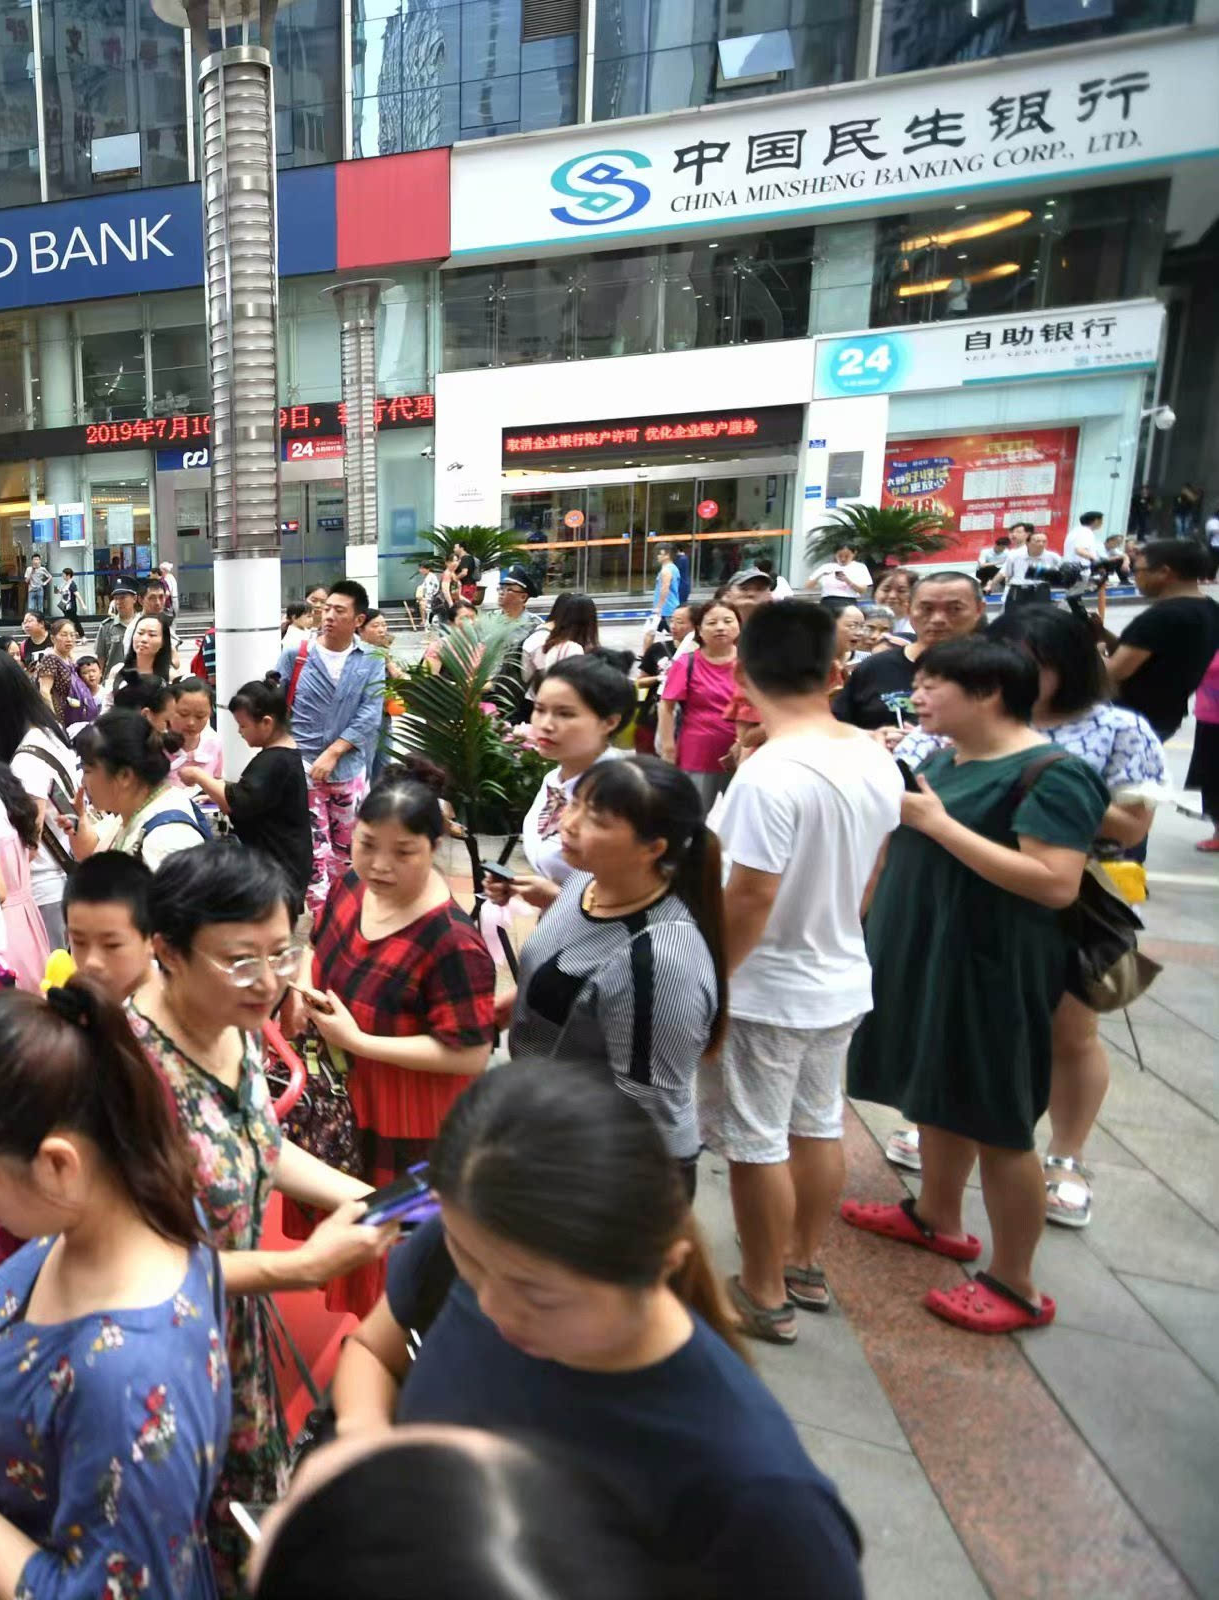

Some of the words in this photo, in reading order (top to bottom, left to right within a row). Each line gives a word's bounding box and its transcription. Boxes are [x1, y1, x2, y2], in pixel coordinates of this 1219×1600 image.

[673, 70, 1151, 187] 中国民生银行
[670, 190, 738, 213] CHINA
[745, 170, 866, 203] MINSHENG
[875, 154, 984, 186] BANKING
[1086, 130, 1143, 154] LTD.
[31, 214, 174, 274] BANK
[964, 317, 1117, 351] 自助银行
[837, 344, 892, 377] 24
[291, 441, 315, 458] 24
